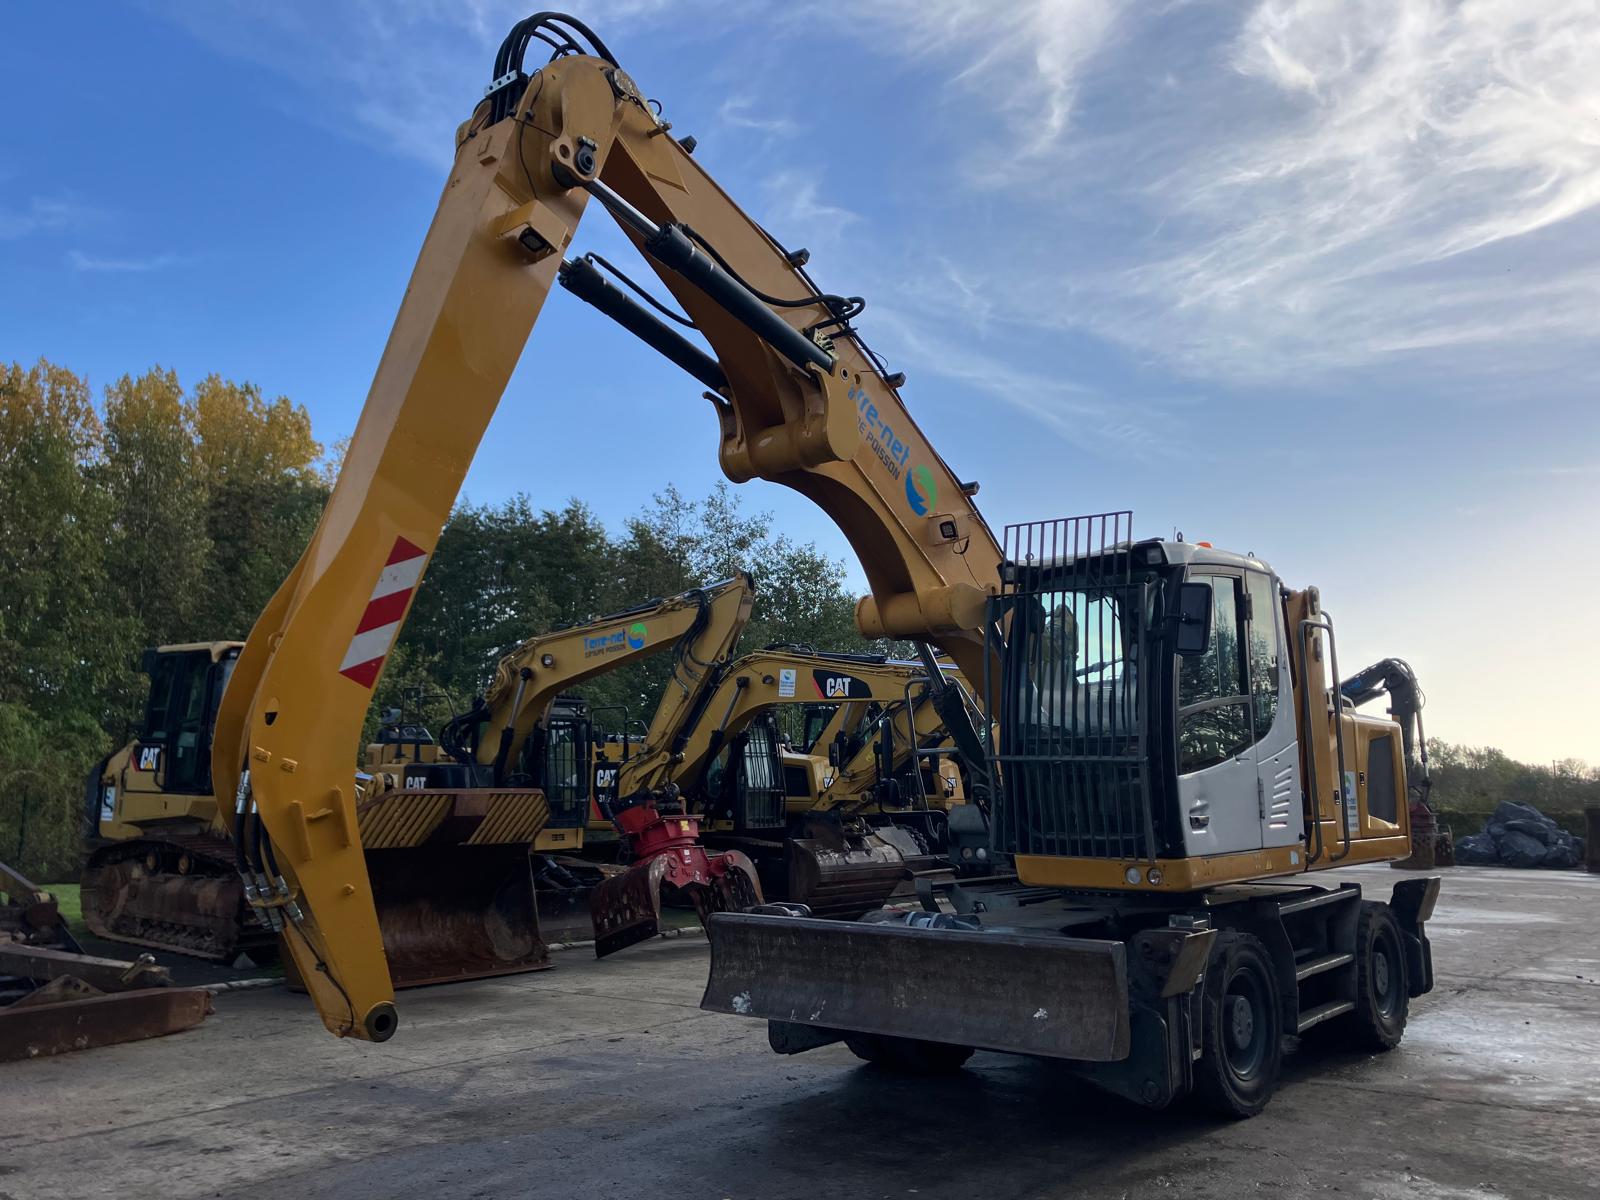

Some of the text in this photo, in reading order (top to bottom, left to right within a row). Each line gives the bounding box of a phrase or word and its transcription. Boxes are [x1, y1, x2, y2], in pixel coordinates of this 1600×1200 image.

[866, 431, 900, 480] POISSON
[826, 677, 851, 697] CAT
[140, 747, 161, 770] CAT
[406, 776, 427, 790] CAT
[597, 769, 616, 787] CAT
